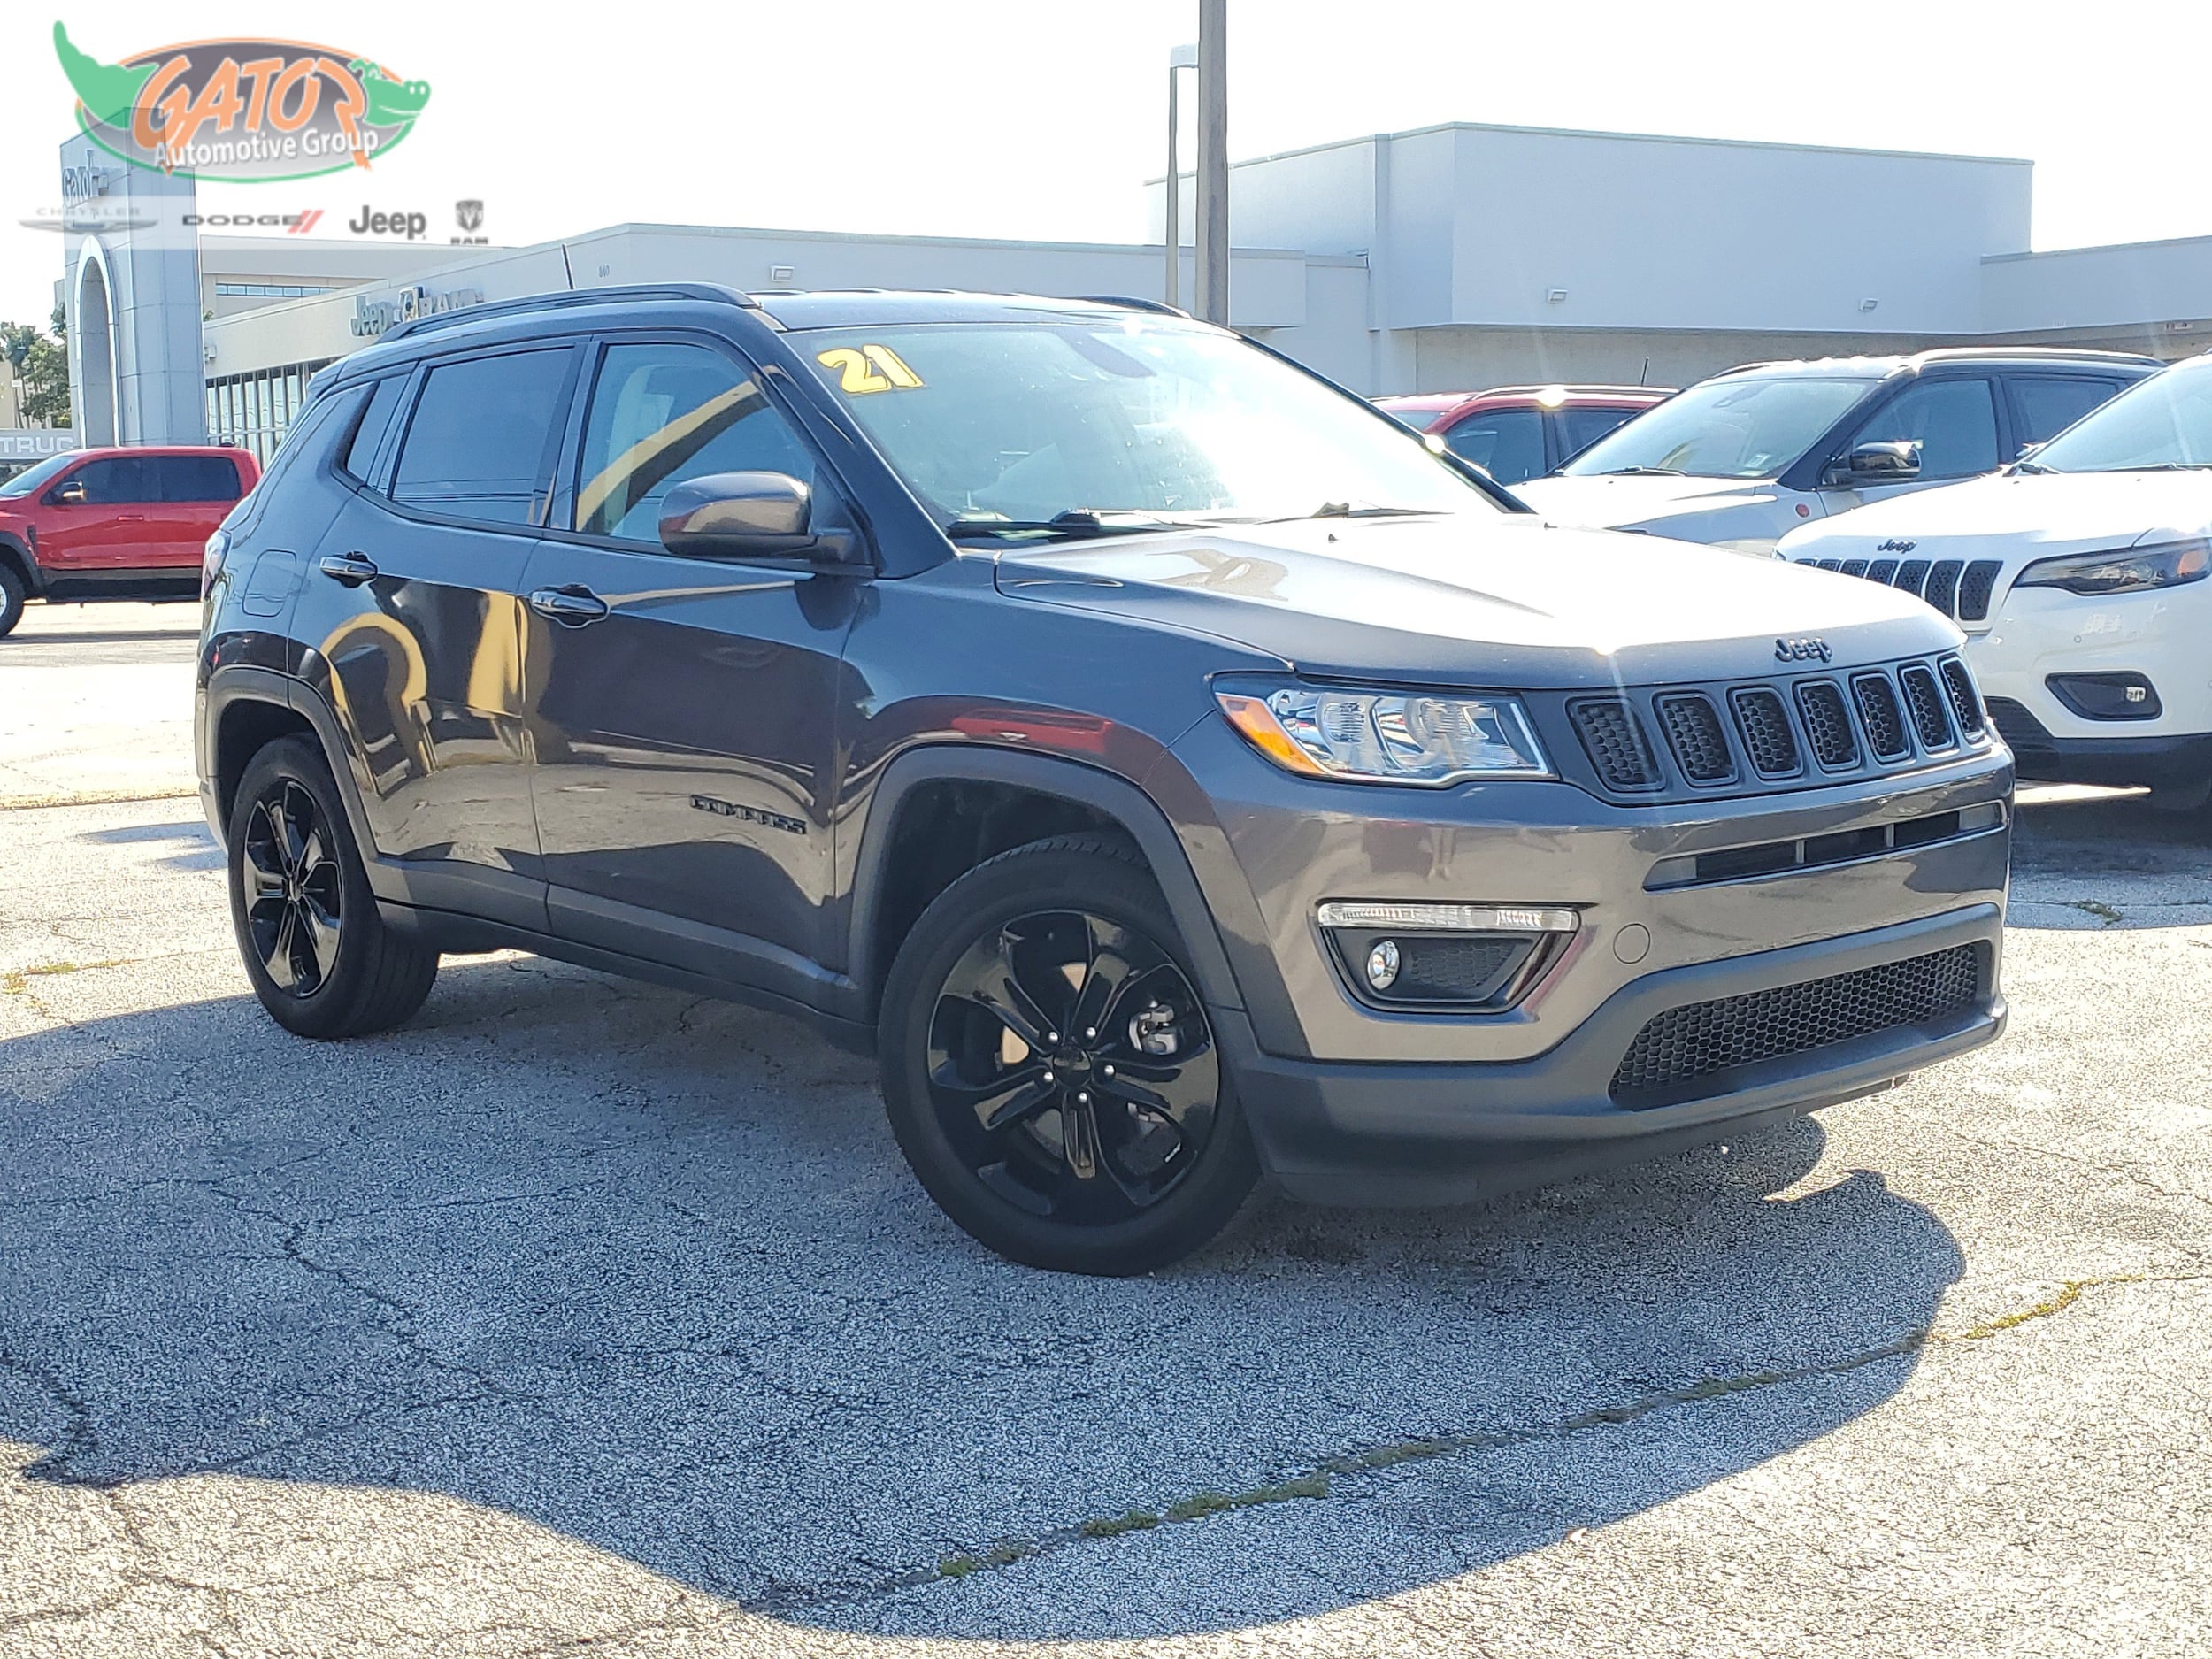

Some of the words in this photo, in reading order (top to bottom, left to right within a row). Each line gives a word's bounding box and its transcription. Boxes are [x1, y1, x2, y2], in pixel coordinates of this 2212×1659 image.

[817, 343, 925, 395] 21
[1877, 538, 1917, 555] Jeep
[1774, 636, 1833, 664] Jeep
